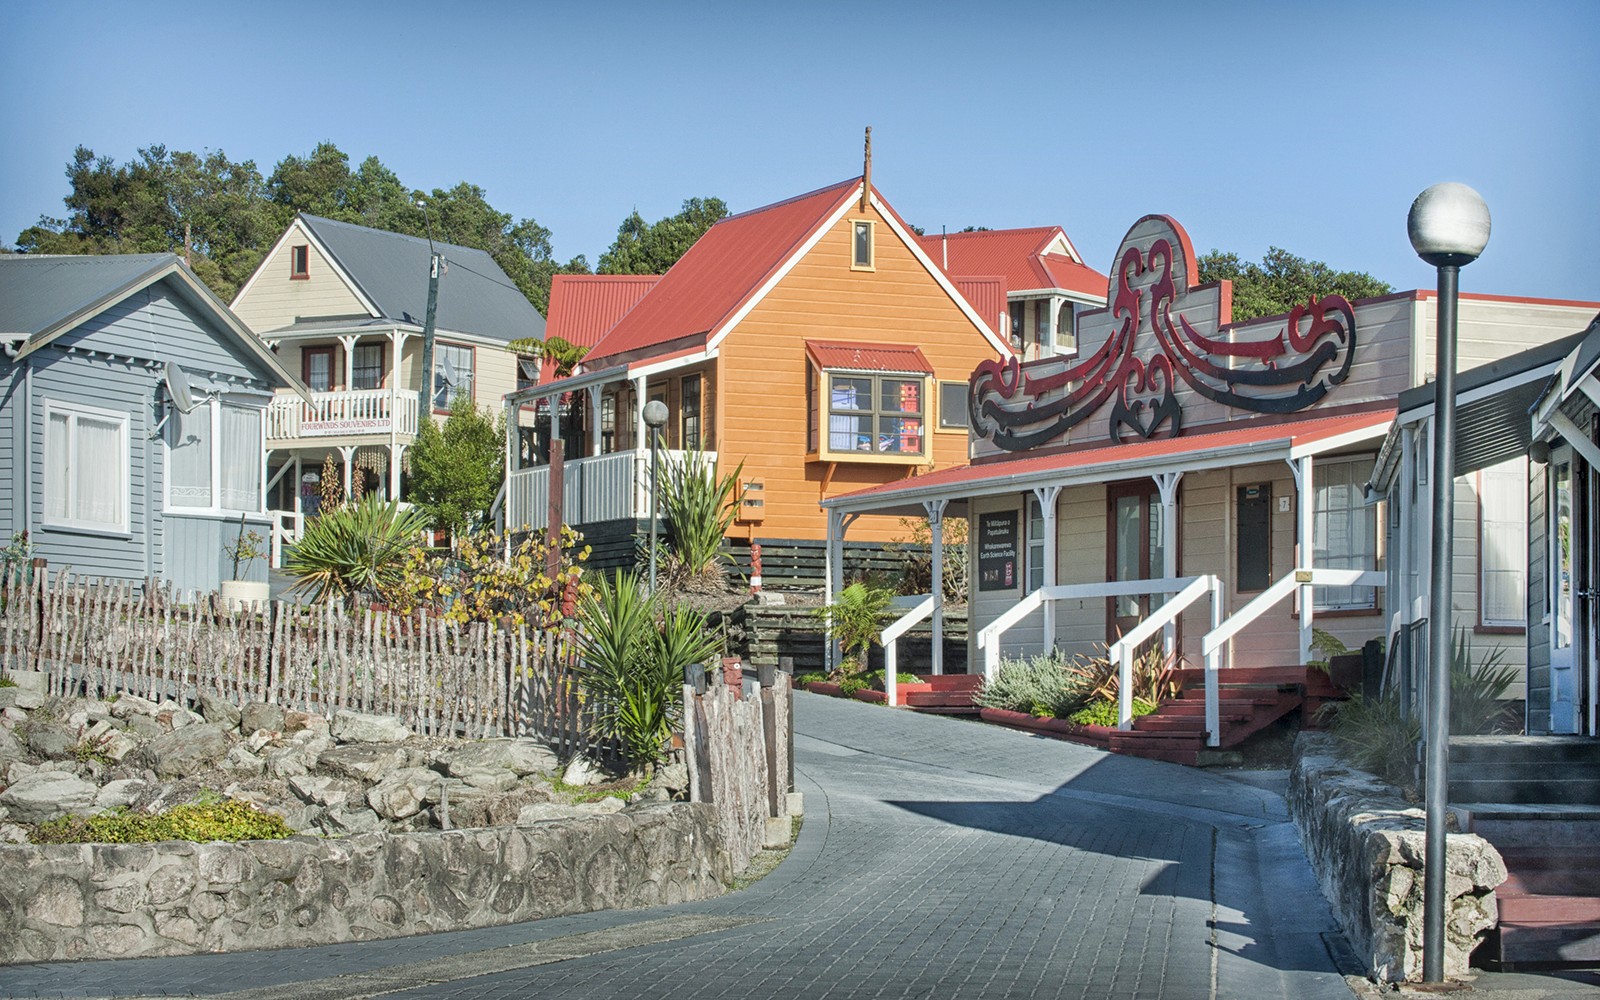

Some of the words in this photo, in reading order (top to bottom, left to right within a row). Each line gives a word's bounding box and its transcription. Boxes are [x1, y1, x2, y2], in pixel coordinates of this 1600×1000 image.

[301, 421, 339, 430] FOURWINDS
[339, 420, 376, 429] SOUVENIRS
[377, 419, 391, 427] LTD
[1003, 550, 1016, 558] Facility
